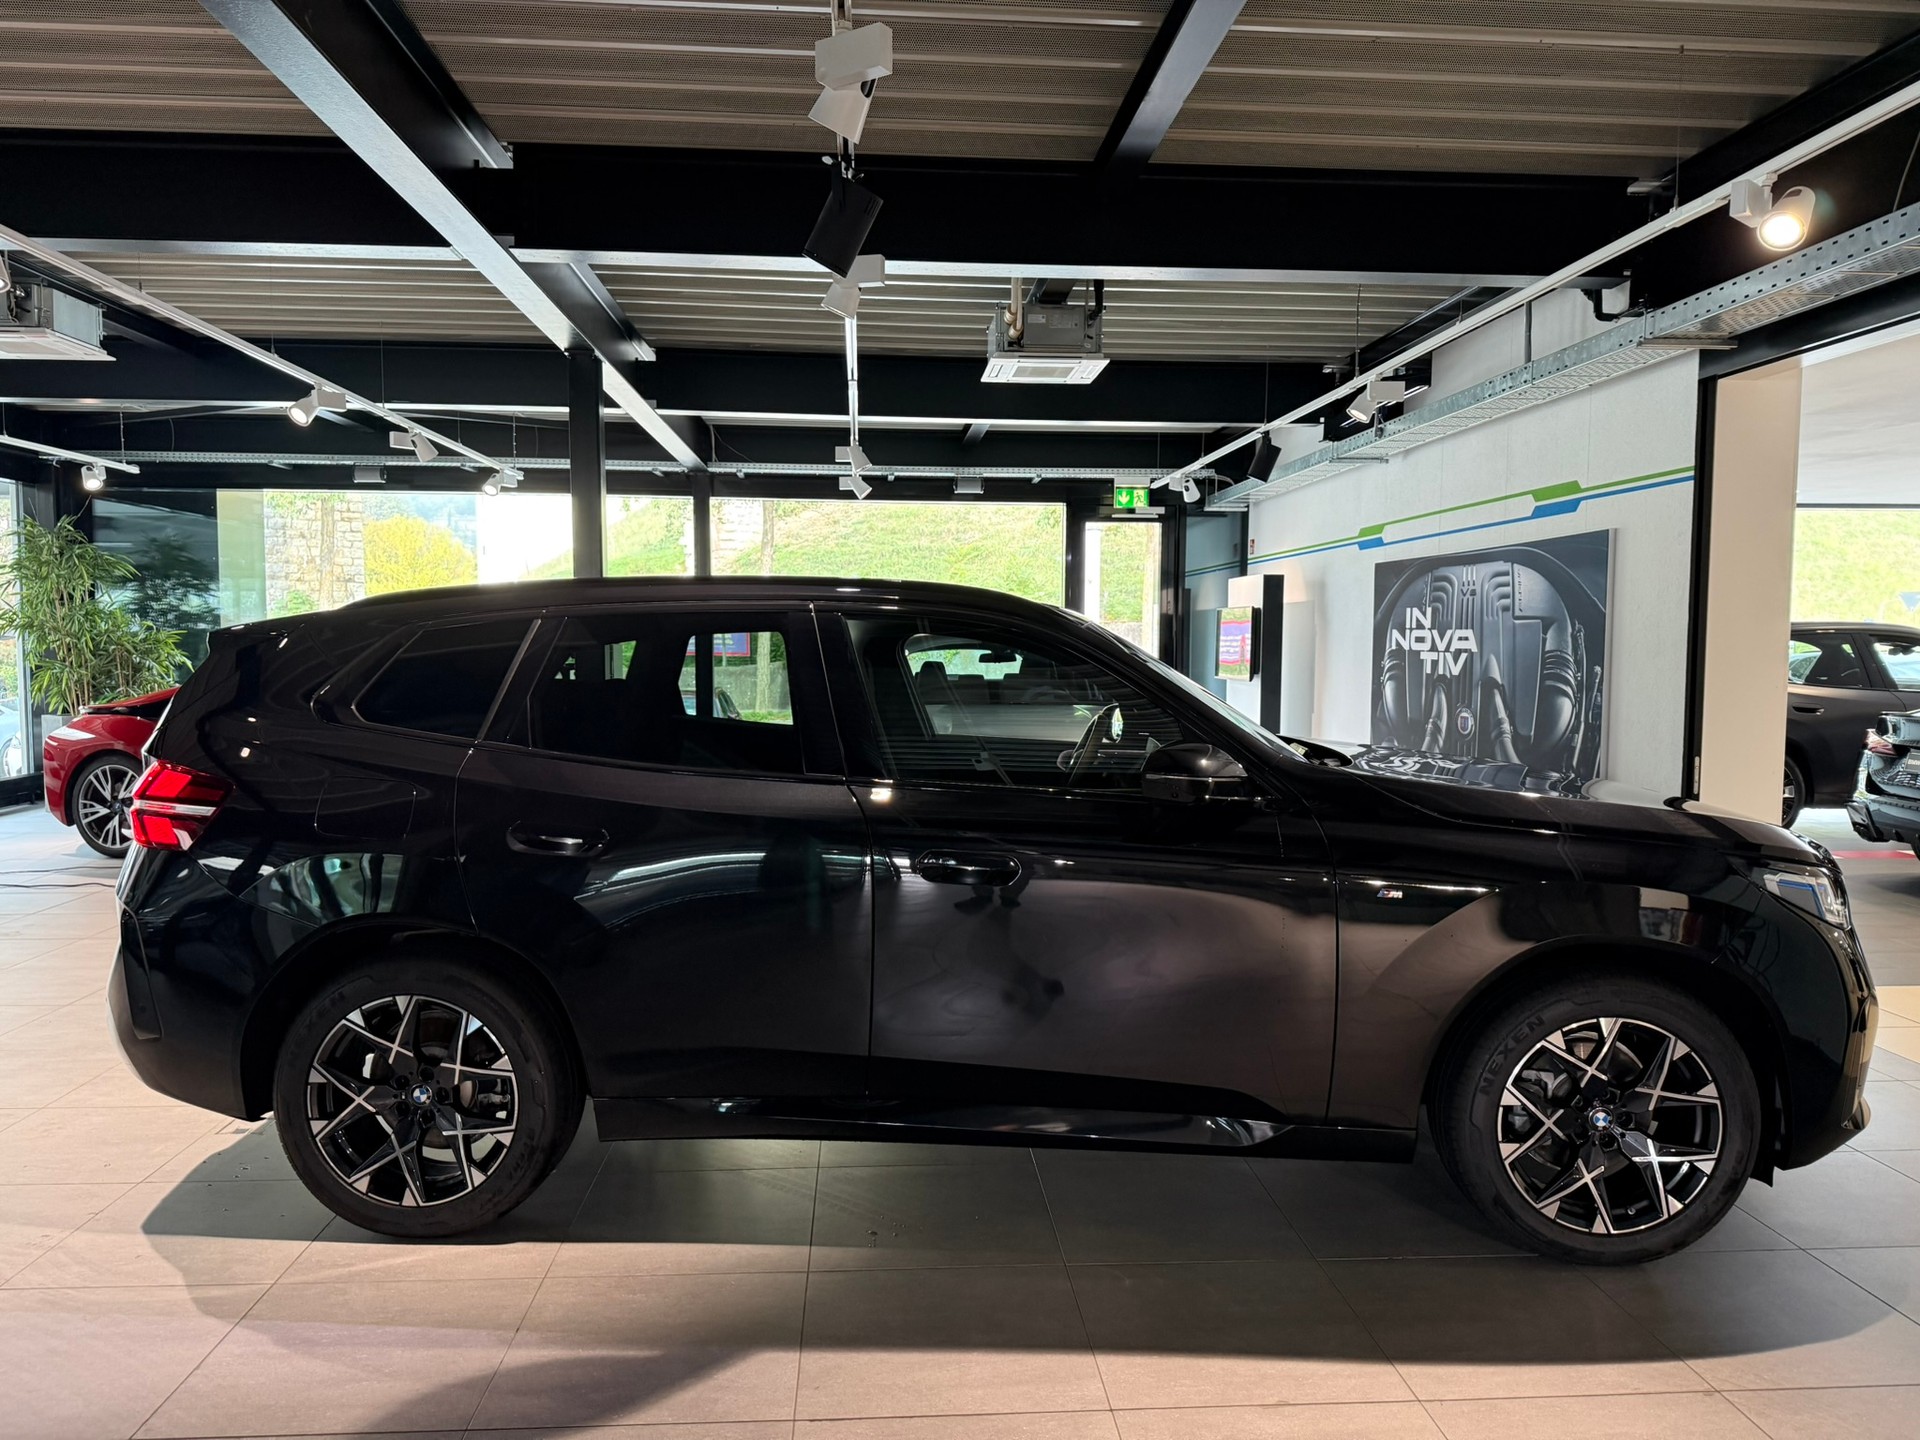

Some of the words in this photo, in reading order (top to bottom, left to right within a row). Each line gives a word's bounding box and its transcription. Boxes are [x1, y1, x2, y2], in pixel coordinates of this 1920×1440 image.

[1405, 607, 1432, 629] IN
[1391, 628, 1478, 653] NOVA
[1420, 651, 1468, 676] TIV
[1479, 1013, 1545, 1096] NEXEN
